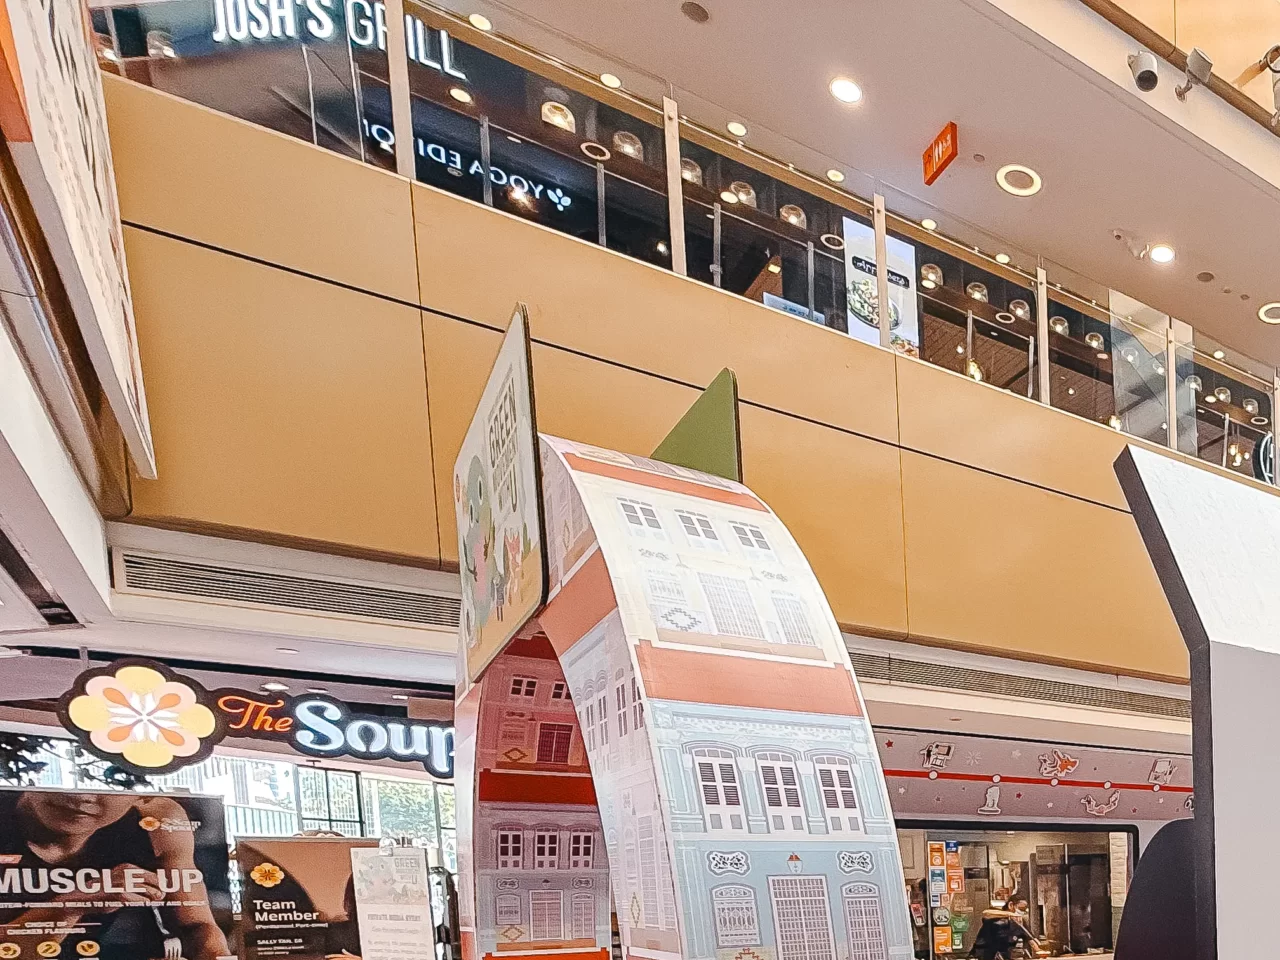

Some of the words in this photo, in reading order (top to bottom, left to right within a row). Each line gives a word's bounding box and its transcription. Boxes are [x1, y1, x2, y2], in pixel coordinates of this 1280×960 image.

[212, 0, 334, 43] JOSH'S
[217, 695, 294, 732] The
[158, 868, 204, 893] UP
[253, 899, 296, 911] Team
[254, 910, 320, 922] Member
